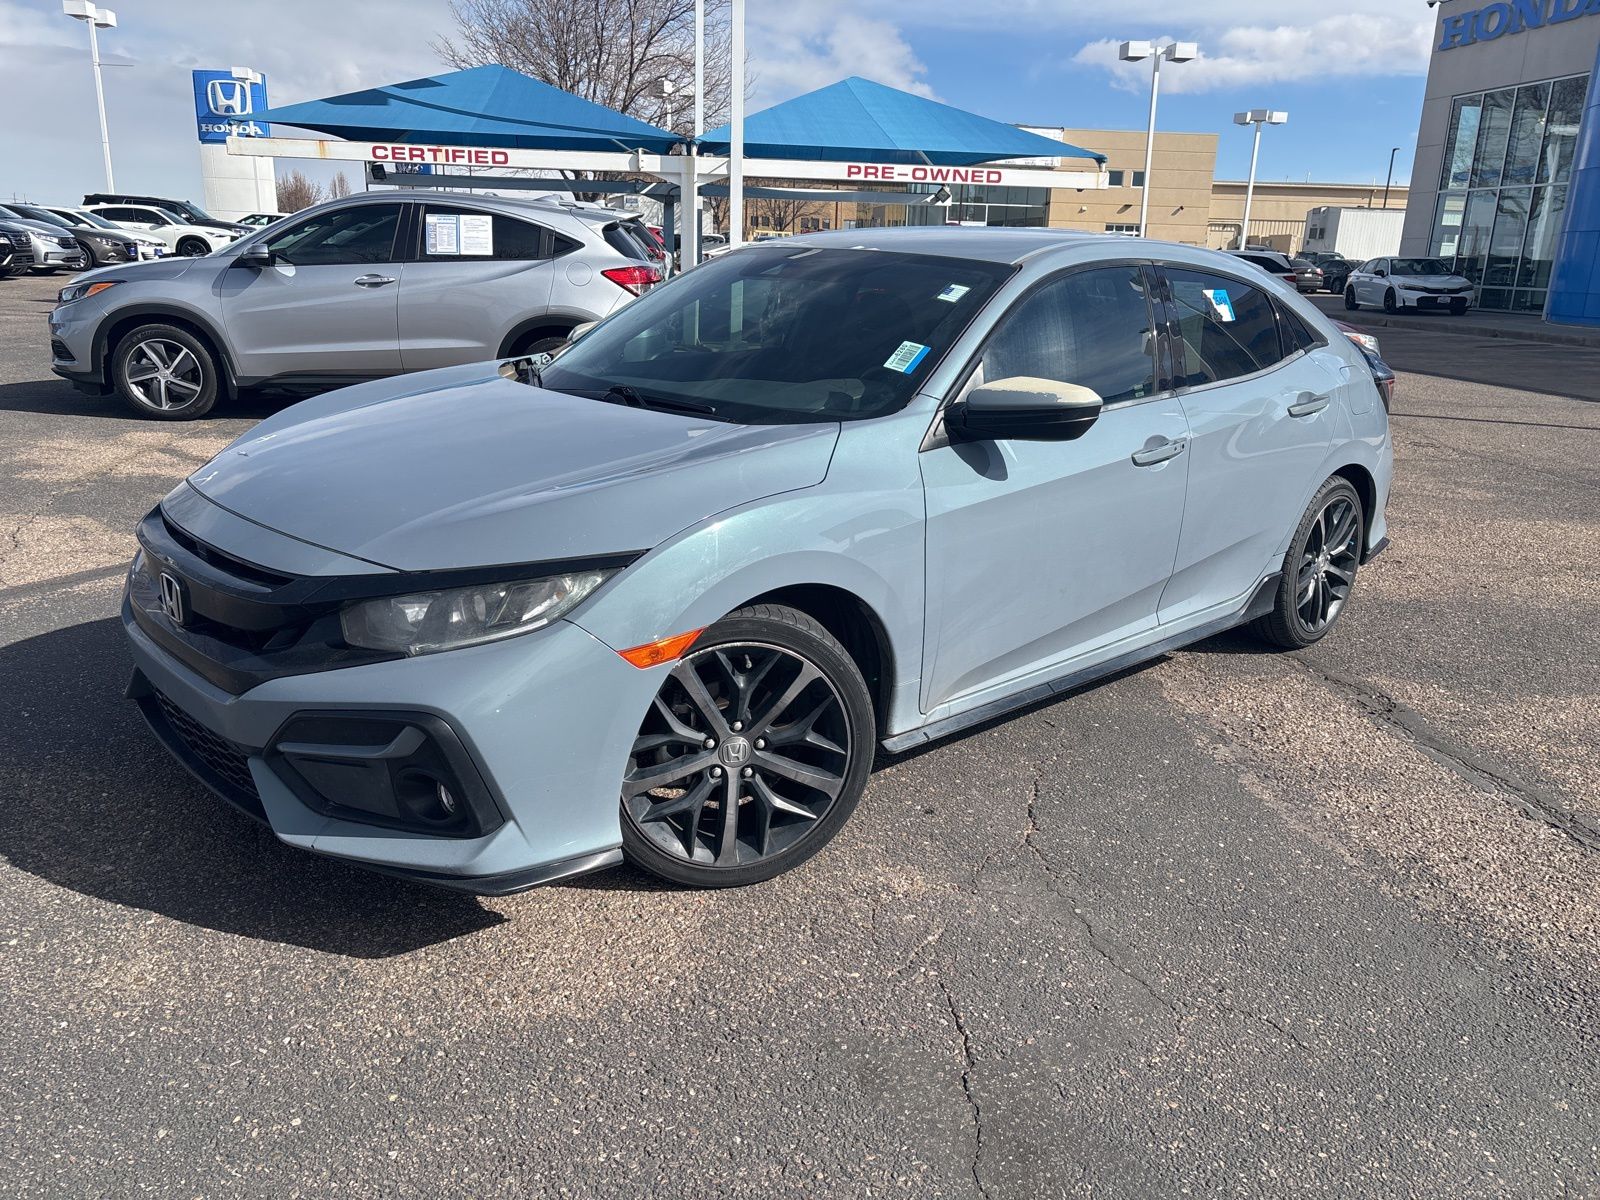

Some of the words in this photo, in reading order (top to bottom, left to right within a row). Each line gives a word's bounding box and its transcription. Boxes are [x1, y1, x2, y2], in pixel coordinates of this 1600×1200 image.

[1438, 0, 1600, 51] HOND
[371, 145, 509, 165] CERTIFIED
[847, 165, 1003, 184] PRE-OWNED
